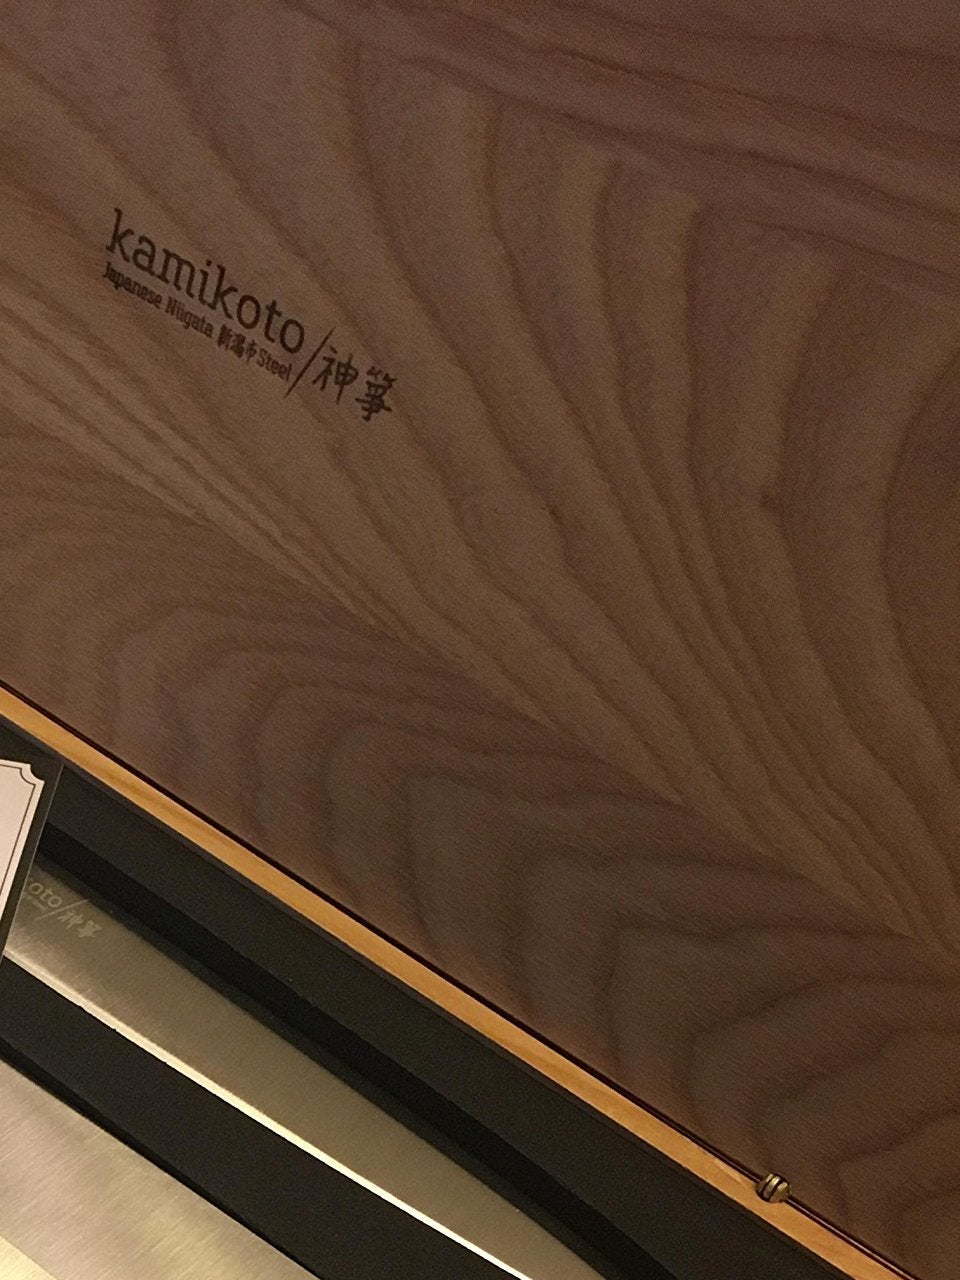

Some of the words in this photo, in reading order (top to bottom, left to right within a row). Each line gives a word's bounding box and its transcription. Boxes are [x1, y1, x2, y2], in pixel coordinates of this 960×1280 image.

[103, 262, 163, 309] Japanese
[257, 348, 293, 382] Steel
[106, 207, 305, 354] kamikoto
